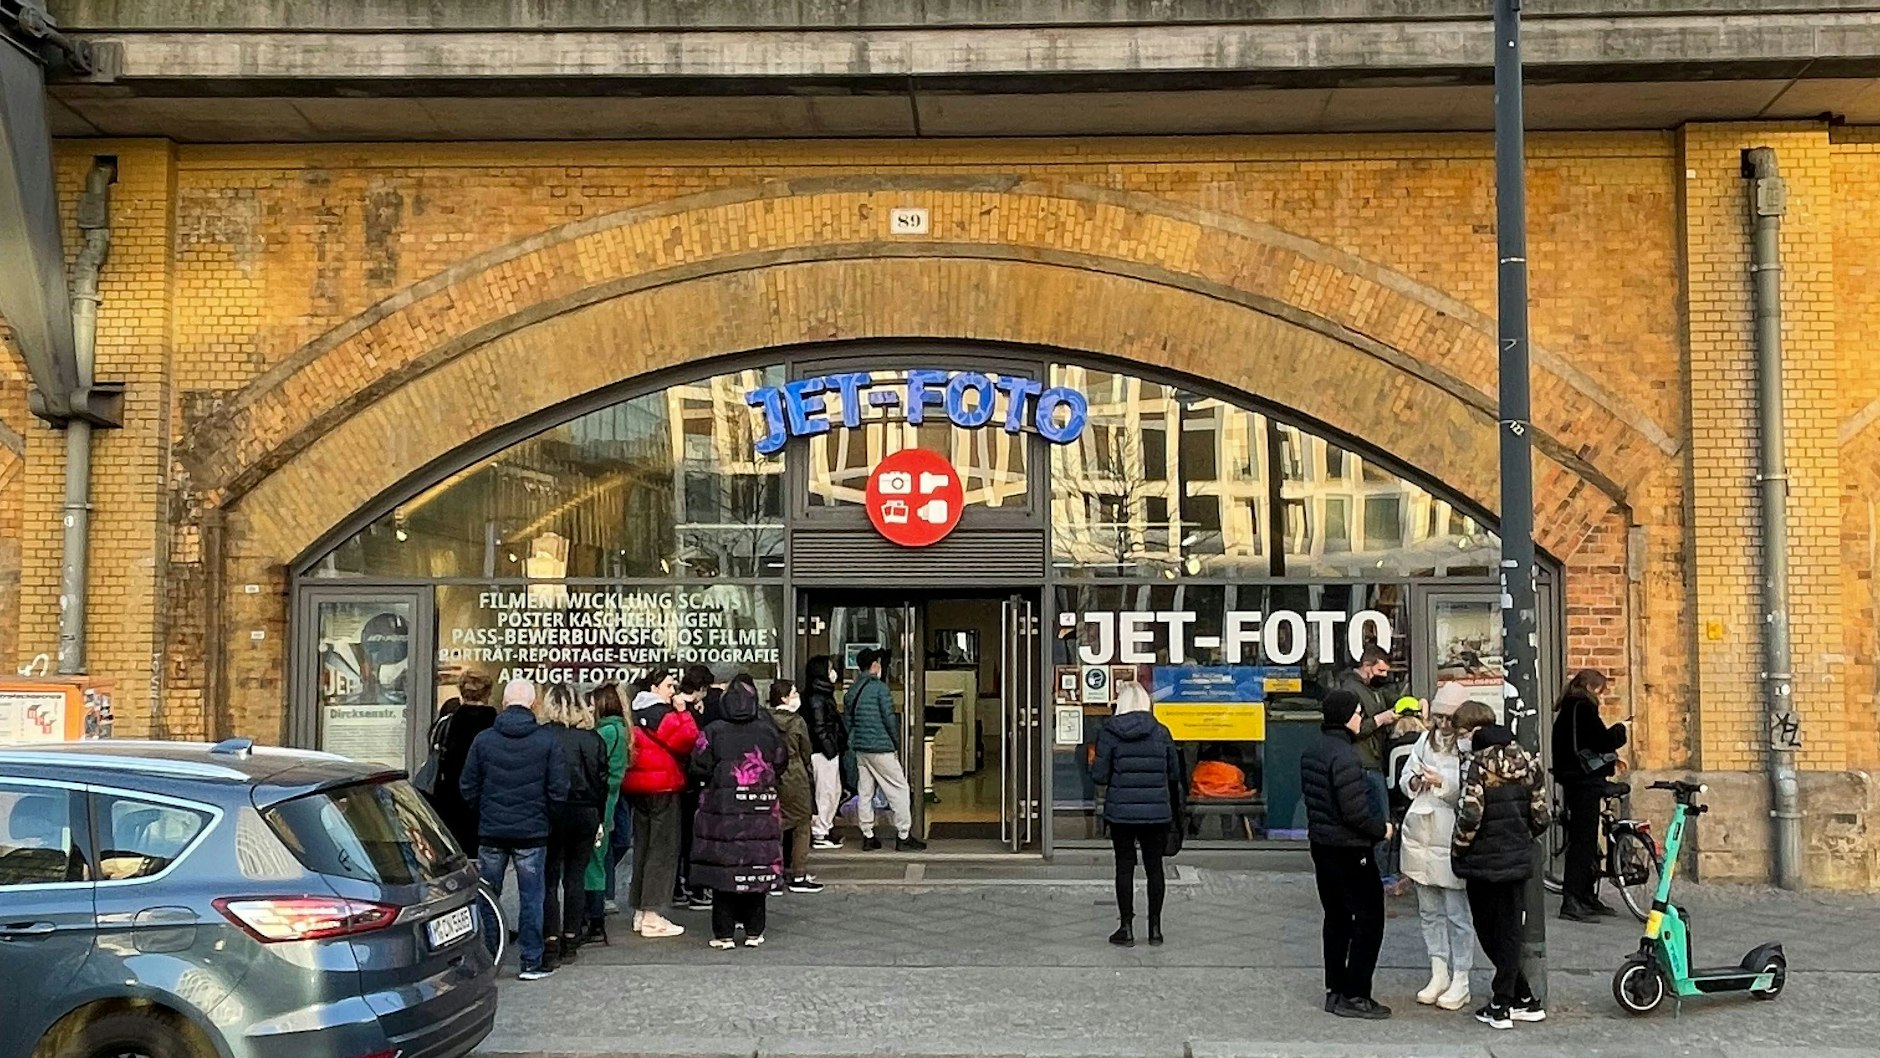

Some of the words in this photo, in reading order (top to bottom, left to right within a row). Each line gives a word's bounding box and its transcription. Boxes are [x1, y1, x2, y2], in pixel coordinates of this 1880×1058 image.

[897, 214, 921, 228] 89
[745, 369, 1088, 455] JET-FOTO
[479, 592, 673, 610] FILMENTWICKLUNG
[678, 592, 742, 610] SCANS
[497, 611, 564, 628] POSTER
[569, 611, 723, 628] KASCHIERUNGEN
[452, 628, 703, 646] PASS-BEWERBUNGSFOTOS
[709, 628, 768, 646] FILME
[1078, 609, 1393, 665] JET-FOTO
[438, 644, 780, 663] PORTRÄT-REPORTAGE-EVENT-FOTOGRAFIE
[498, 663, 574, 685] ABZÜGE
